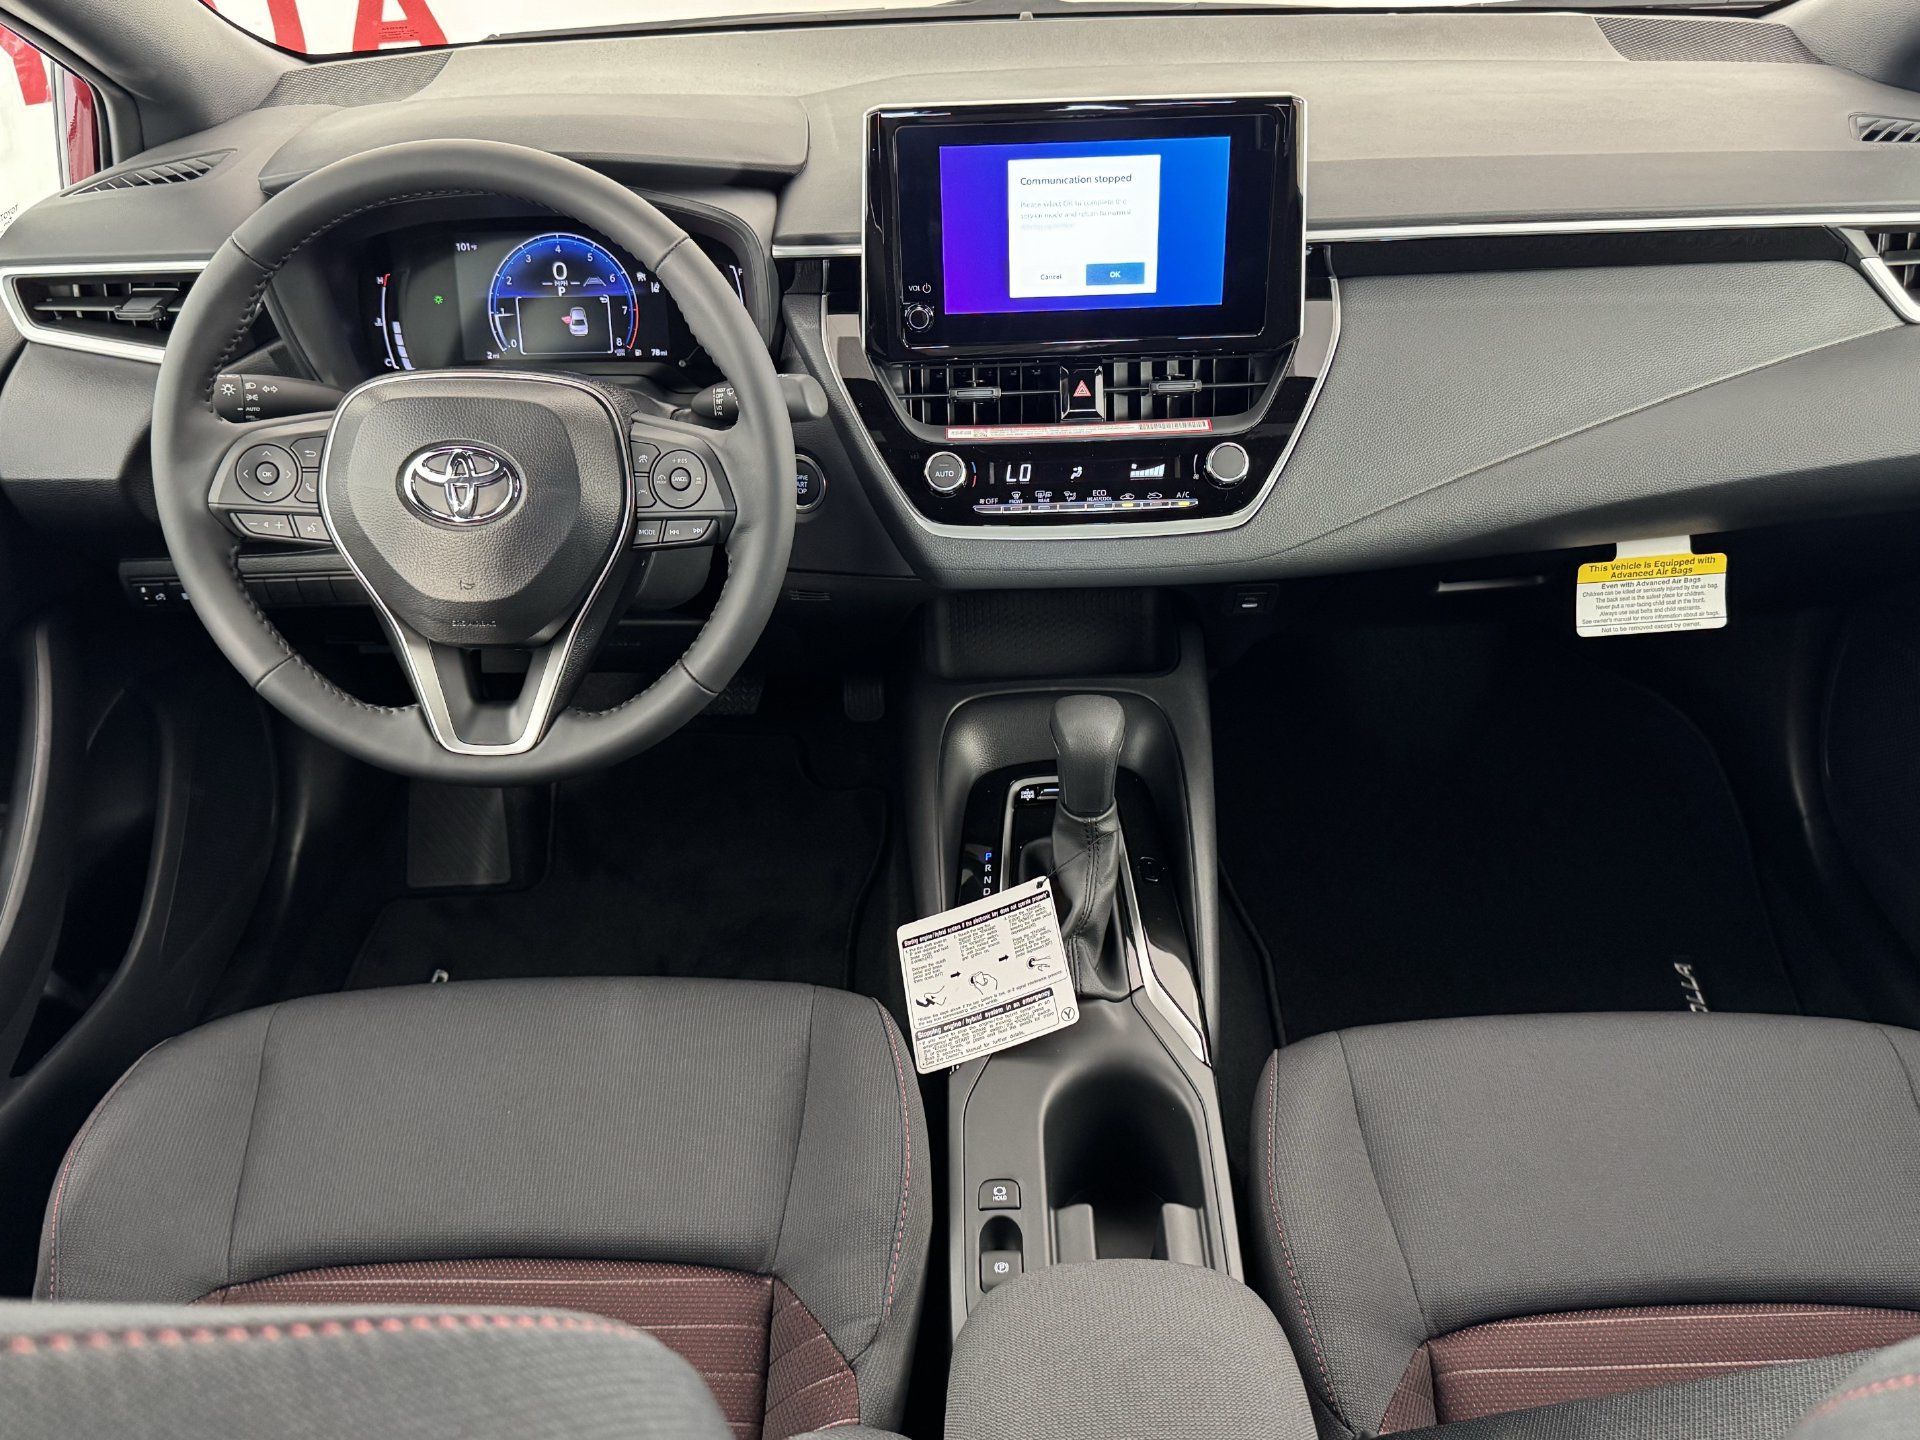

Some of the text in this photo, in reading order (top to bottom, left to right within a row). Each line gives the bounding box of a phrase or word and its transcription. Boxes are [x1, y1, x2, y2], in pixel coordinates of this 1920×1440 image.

[1020, 174, 1132, 186] Communication stopped
[588, 253, 593, 261] 5
[622, 306, 628, 314] 7
[616, 338, 622, 346] 8
[1611, 561, 1642, 570] Vehicle
[1654, 557, 1695, 568] Equipped
[1698, 555, 1715, 564] with
[1611, 569, 1653, 578] Advanced
[1671, 566, 1692, 576] Bags
[983, 852, 992, 896] P R N D
